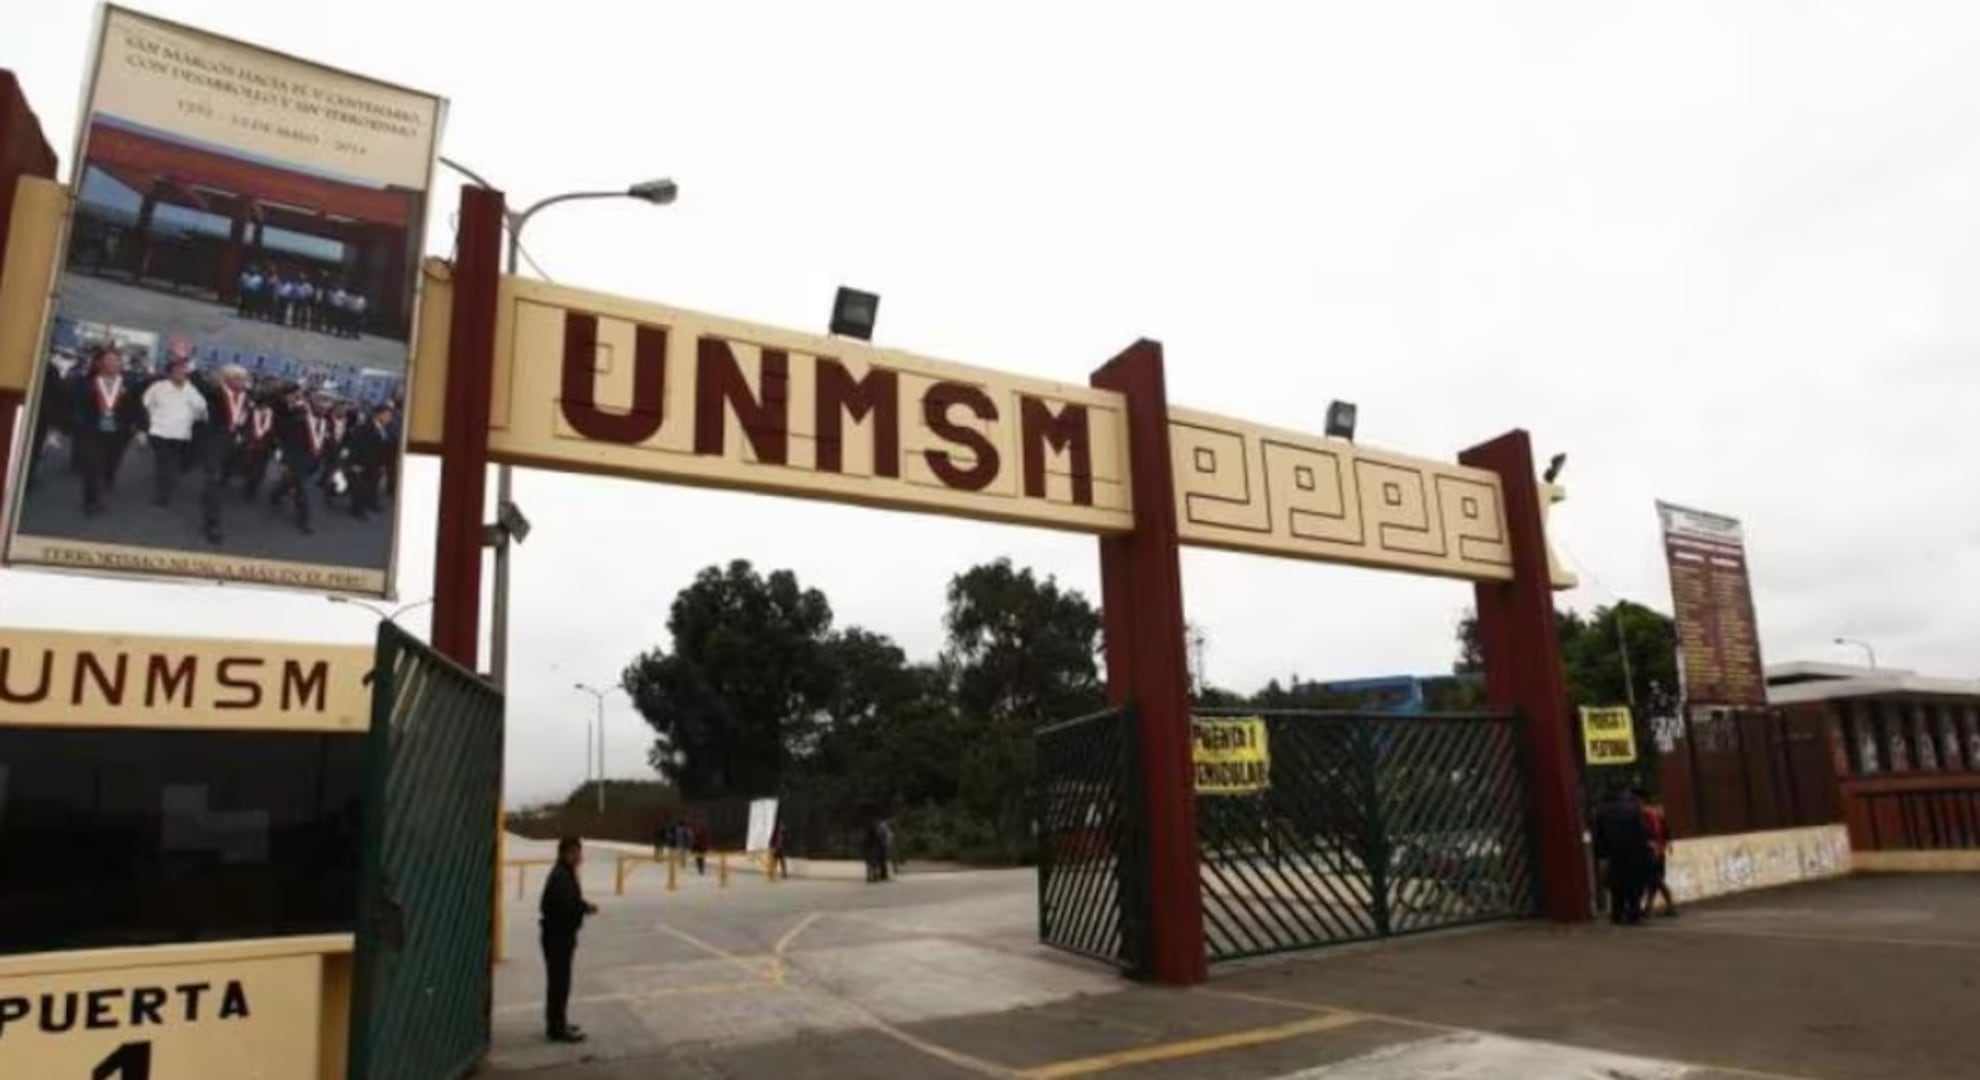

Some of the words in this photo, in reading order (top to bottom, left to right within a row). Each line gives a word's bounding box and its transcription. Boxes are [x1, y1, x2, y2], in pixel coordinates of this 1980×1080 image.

[560, 312, 1094, 506] UNMSM
[0, 647, 329, 713] UNMSM
[0, 980, 250, 1038] PUERTA
